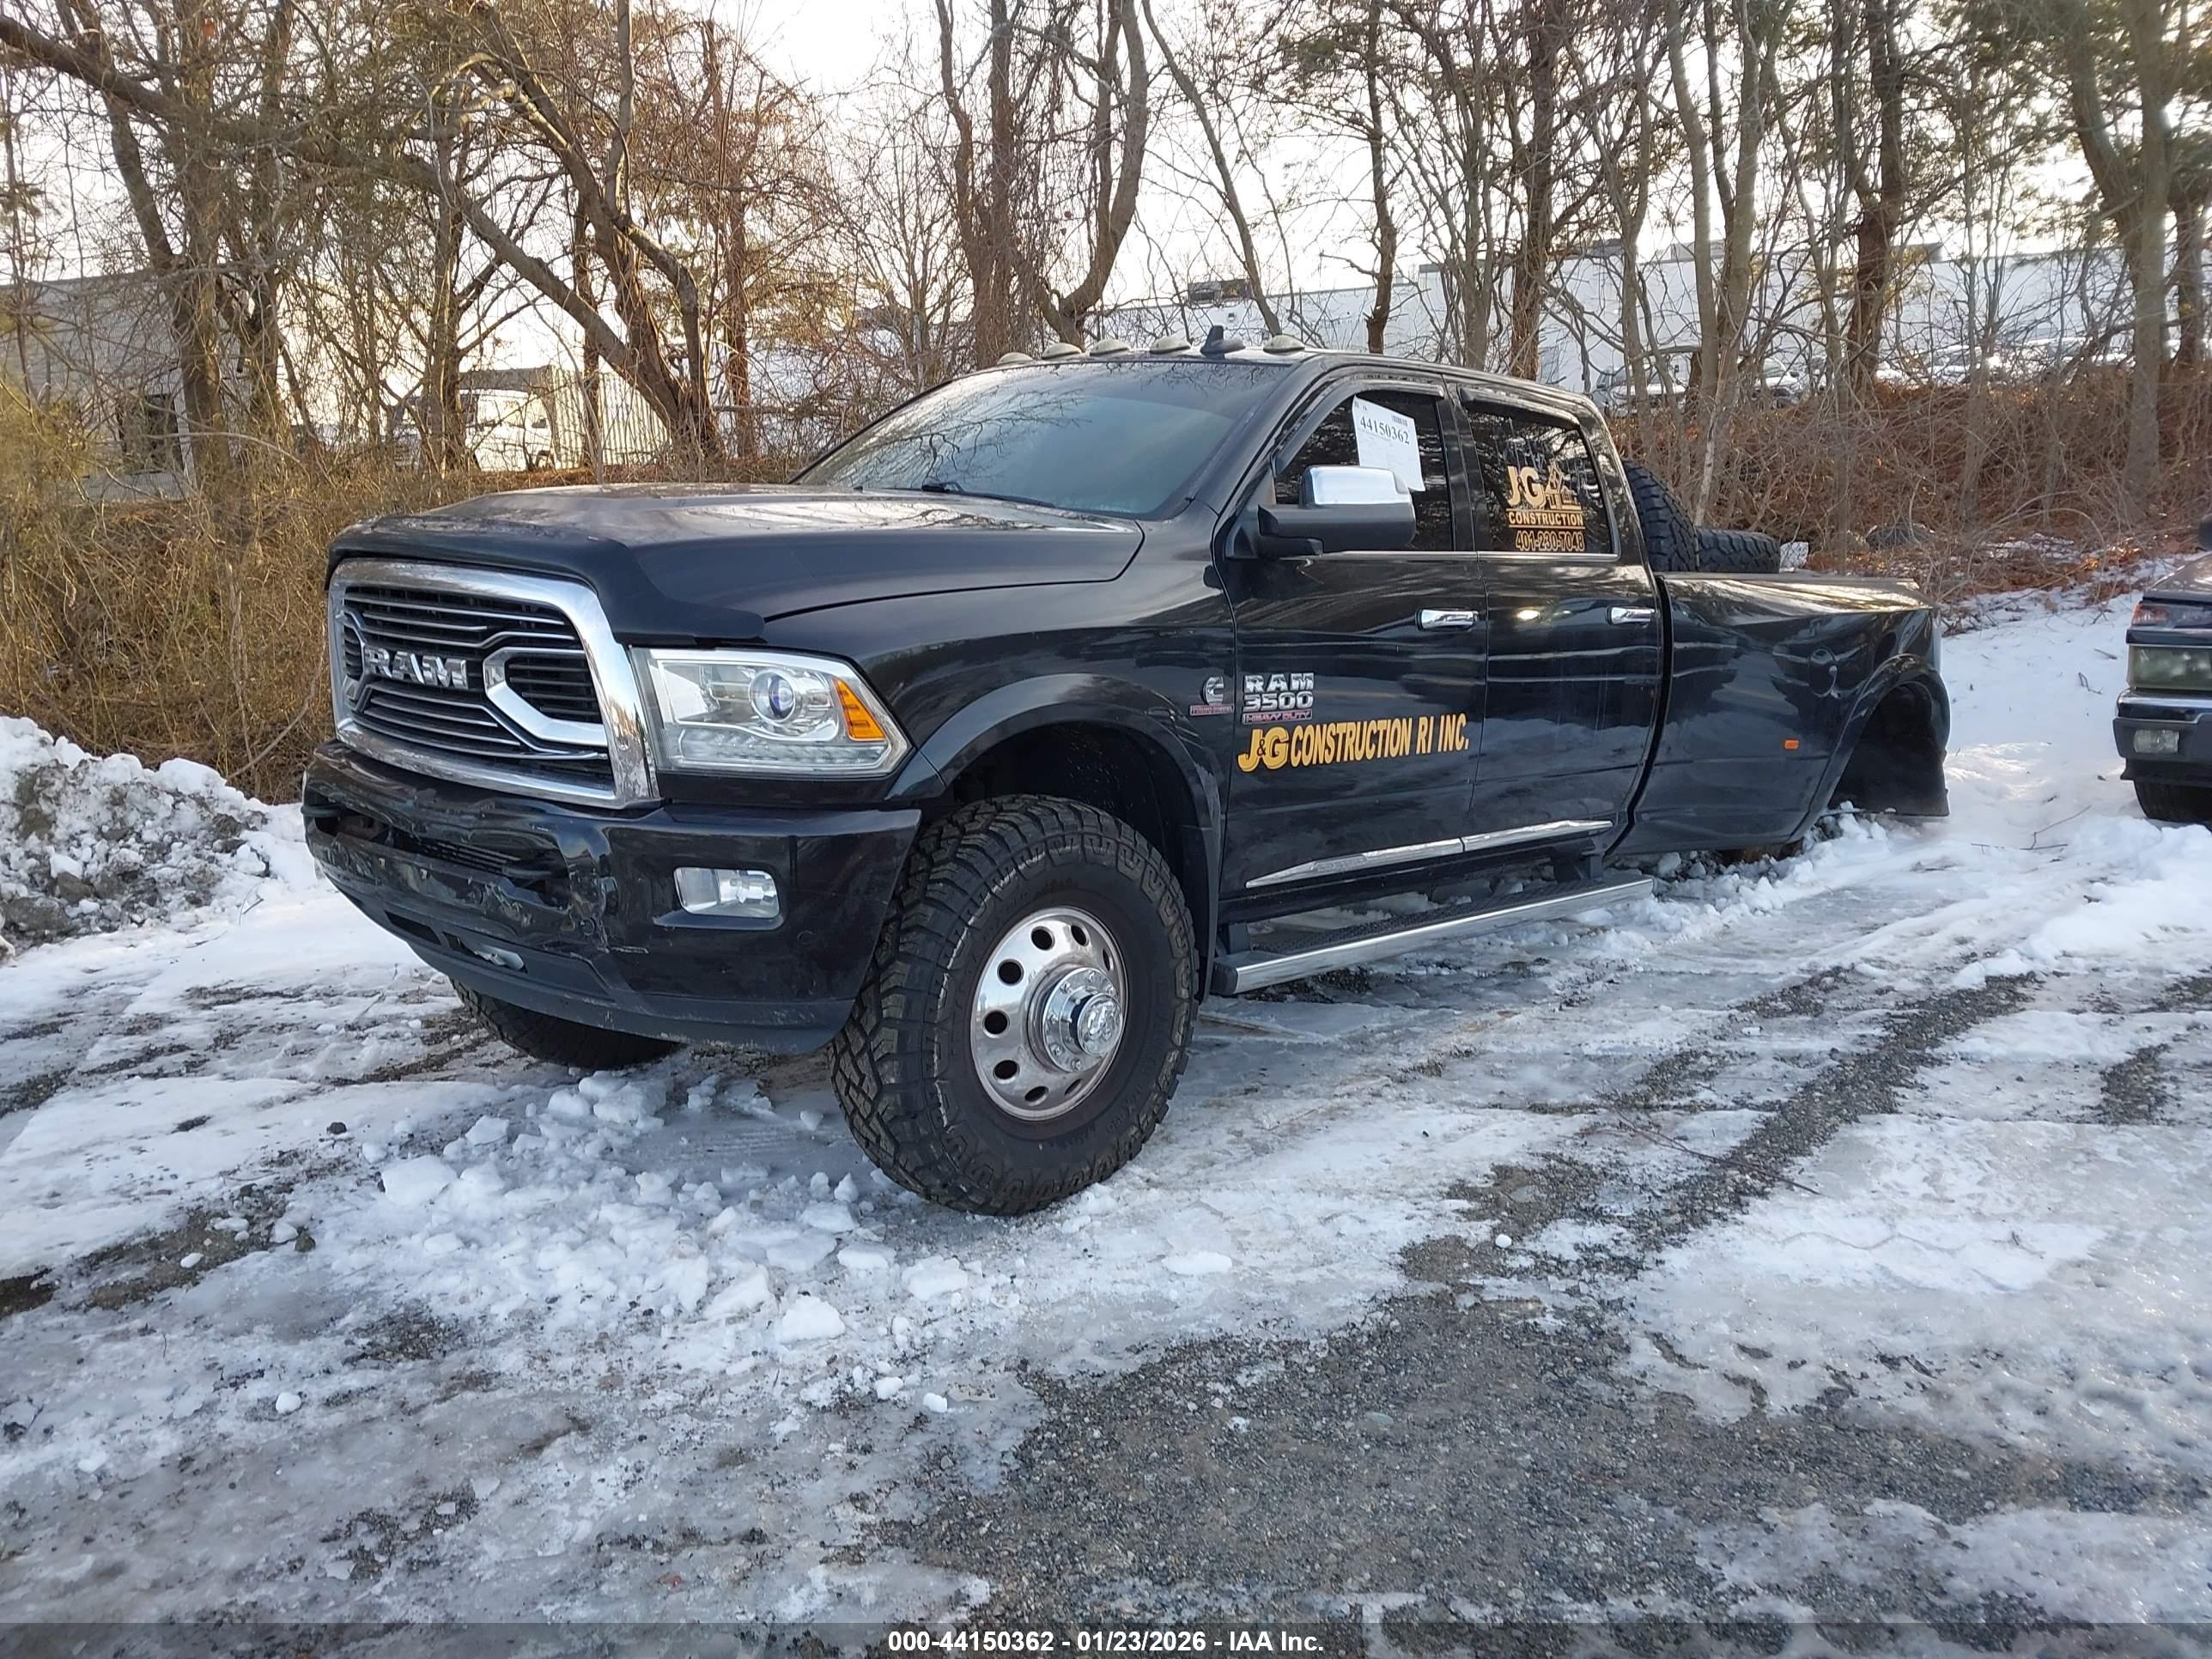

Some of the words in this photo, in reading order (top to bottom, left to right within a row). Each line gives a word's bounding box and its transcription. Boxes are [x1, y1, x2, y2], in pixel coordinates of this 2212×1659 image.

[1360, 416, 1410, 445] 44150362
[1509, 512, 1584, 526] CONSTRUCTION
[1516, 530, 1585, 551] 401-230-7048
[365, 646, 469, 690] RAM
[1244, 672, 1315, 694] RAM
[1243, 690, 1315, 713] 3500
[1237, 726, 1289, 773] J&G
[1290, 718, 1413, 768] CONSTRUCTION
[1416, 715, 1434, 754] RI
[1437, 713, 1469, 753] INC.
